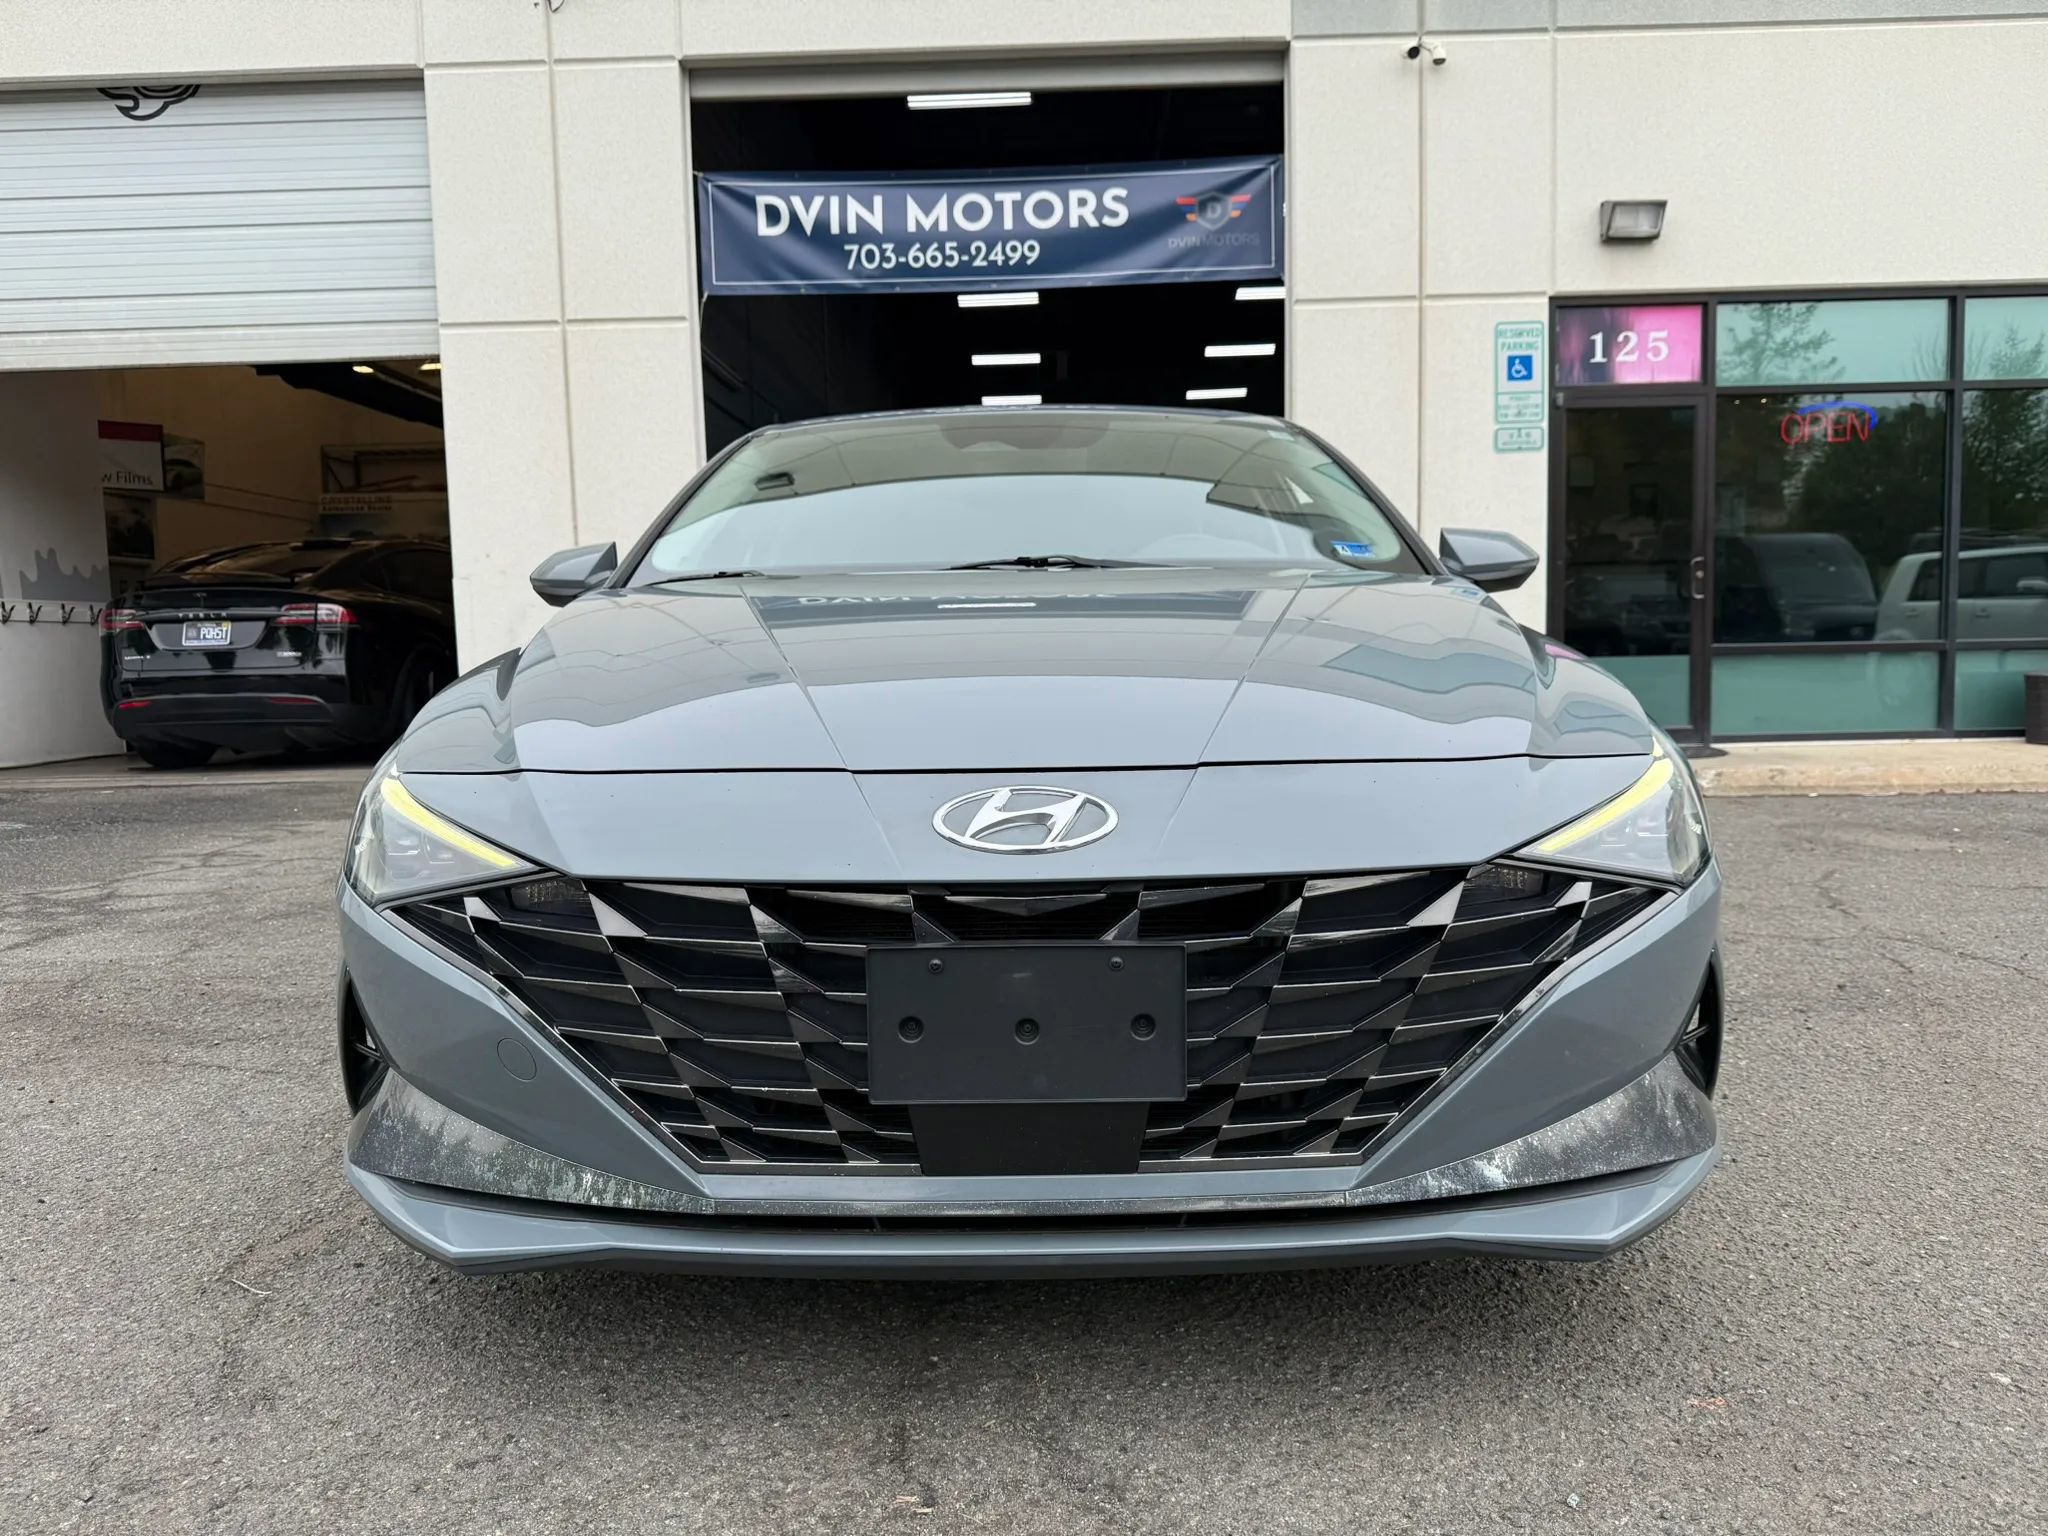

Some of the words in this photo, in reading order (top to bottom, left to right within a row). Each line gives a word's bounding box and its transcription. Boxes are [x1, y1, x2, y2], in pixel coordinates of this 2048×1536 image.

[755, 193, 884, 238] DVIN
[906, 187, 1130, 233] MOTORS
[843, 239, 1041, 271] 703-665-2499
[1497, 327, 1543, 338] RESERVED
[1501, 341, 1539, 352] PARKING
[1588, 329, 1669, 363] 125
[1780, 411, 1870, 446] OPEN
[116, 470, 154, 486] Films
